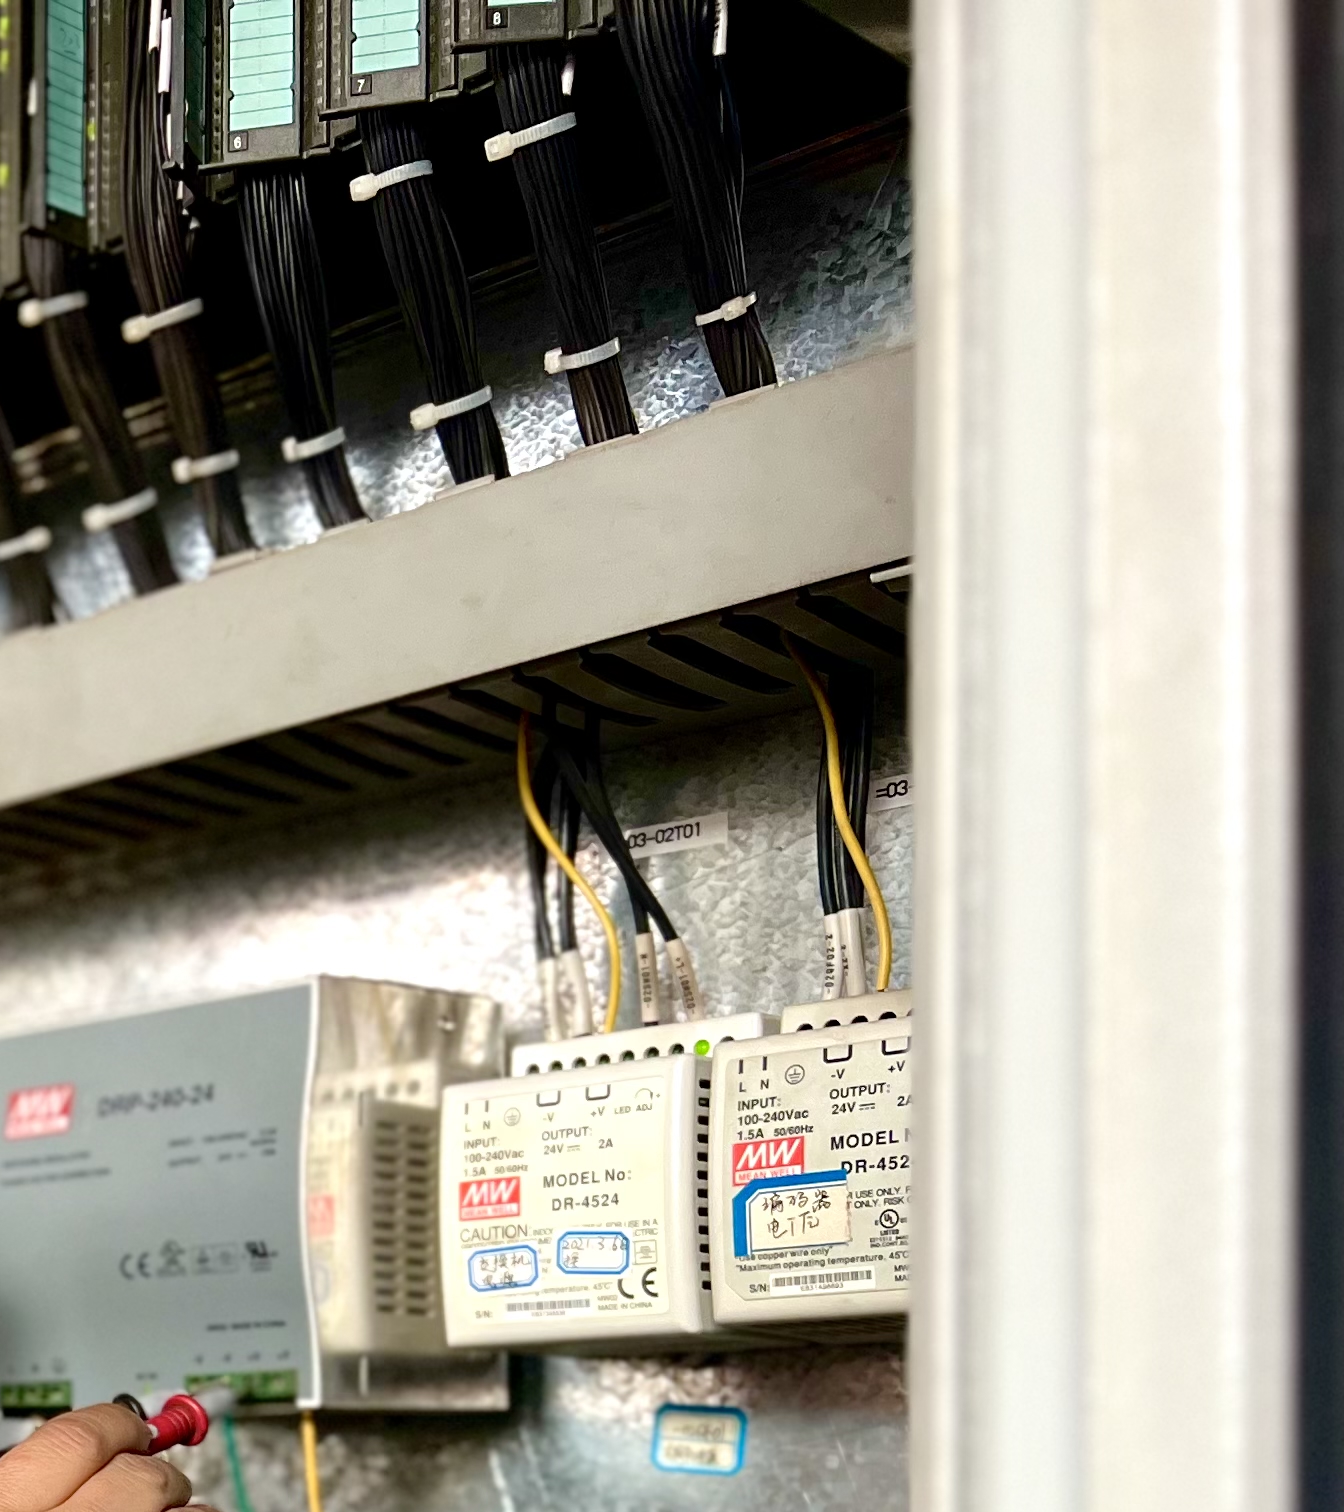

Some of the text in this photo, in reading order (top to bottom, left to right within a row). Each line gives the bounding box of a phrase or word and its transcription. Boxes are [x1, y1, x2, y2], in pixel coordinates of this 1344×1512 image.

[493, 11, 502, 25] 8
[357, 79, 366, 92] 7
[234, 136, 242, 150] 6
[739, 1079, 769, 1093] L N
[829, 1083, 891, 1100] OUTPUT:
[738, 1096, 781, 1111] INPUT:
[832, 1102, 856, 1115] 24V
[482, 1121, 490, 1130] N
[738, 1110, 809, 1127] 100-240Vac
[541, 1126, 592, 1141] OUTPUT:
[737, 1125, 814, 1140] 1.5A 50/60Hz
[830, 1130, 900, 1150] MODEL
[463, 1137, 500, 1149] INPUT:
[544, 1138, 614, 1155] 24V 2A
[464, 1149, 525, 1163] 100-240Vac
[736, 1139, 801, 1170] MW
[543, 1168, 632, 1188] MODEL No:
[462, 1179, 517, 1206] MW
[551, 1192, 620, 1212] DR-4524
